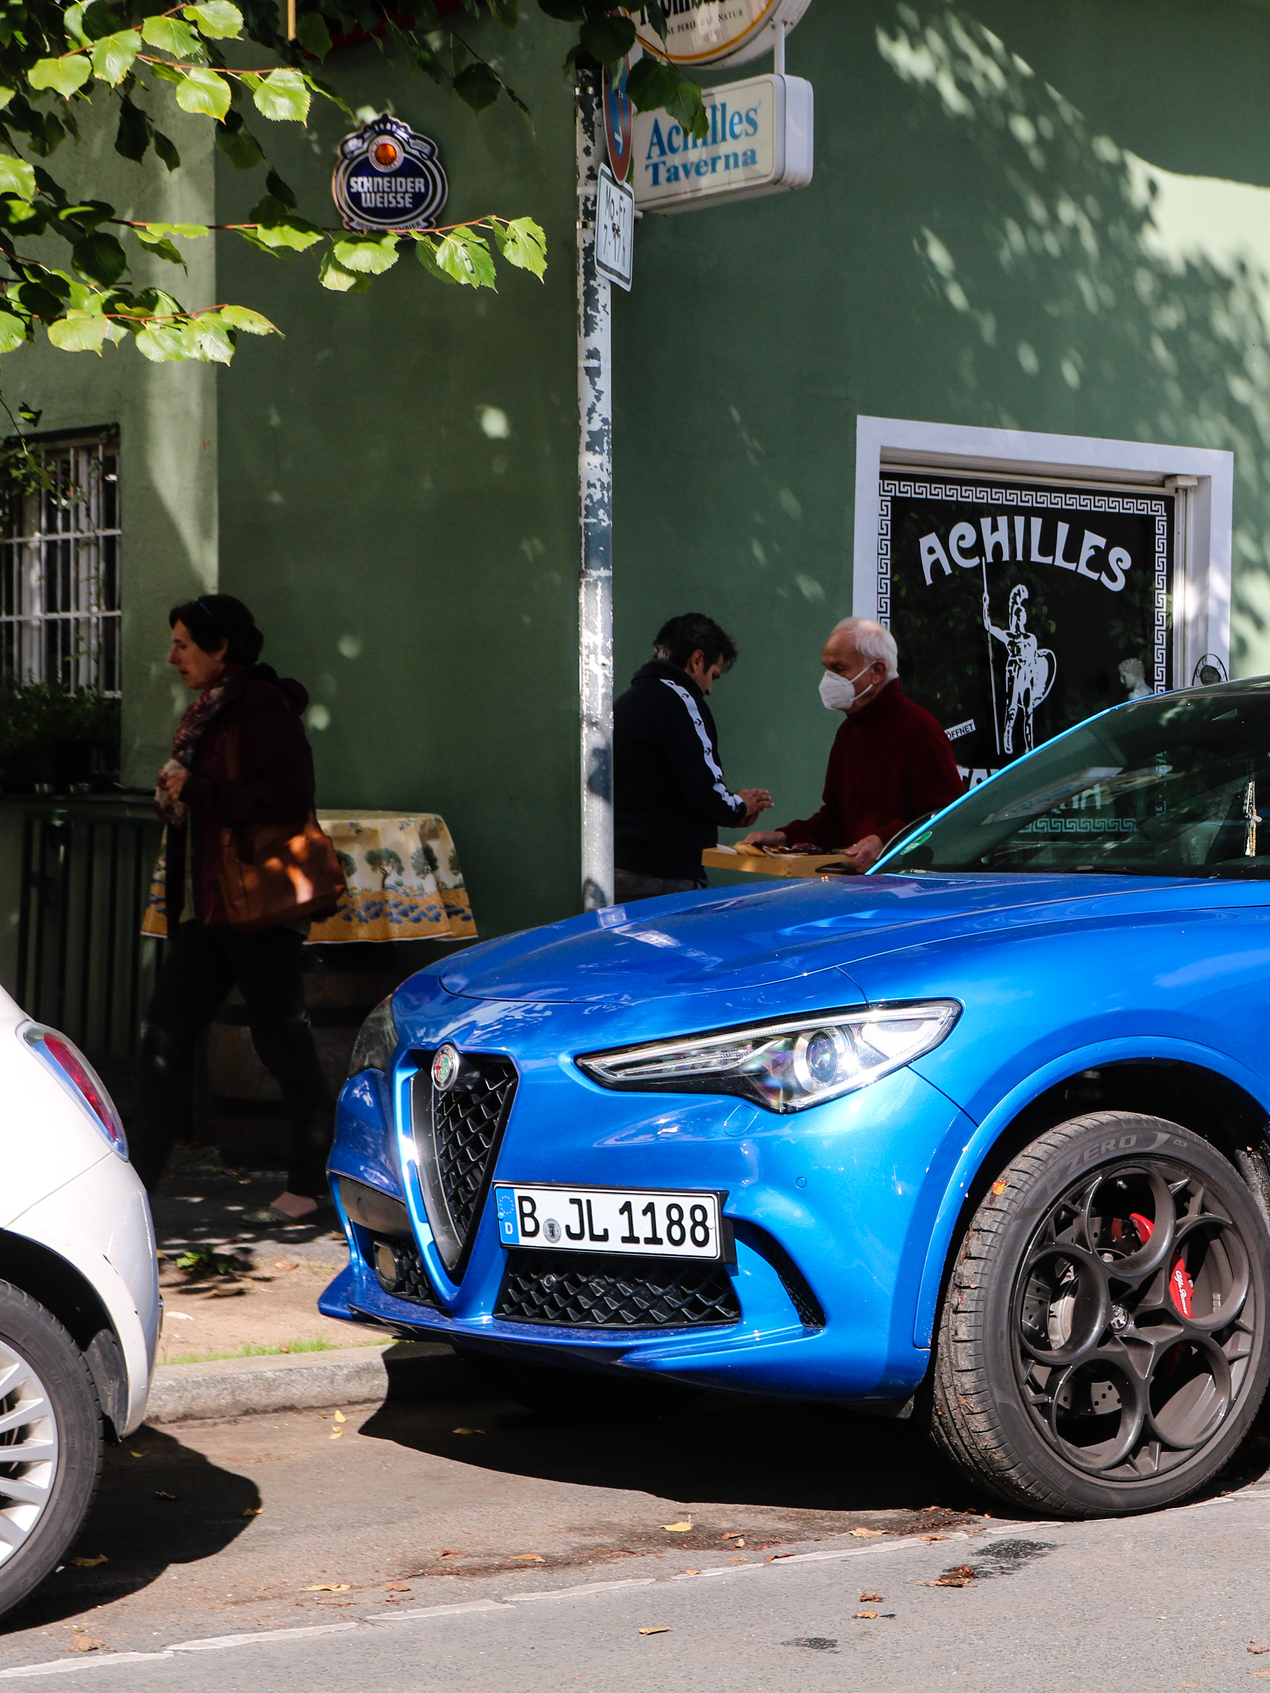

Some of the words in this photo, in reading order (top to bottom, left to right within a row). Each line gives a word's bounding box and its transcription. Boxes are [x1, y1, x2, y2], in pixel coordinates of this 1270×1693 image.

[718, 9, 744, 23] NATUR
[645, 147, 759, 188] Taverna
[350, 176, 425, 193] SCHNEIDER
[361, 192, 413, 208] WEISSE
[919, 515, 1132, 592] ACHILLES
[1066, 1134, 1138, 1173] ZERO
[505, 1222, 514, 1235] D
[517, 1195, 540, 1238] B
[565, 1198, 609, 1242] JL
[619, 1200, 710, 1248] 1188
